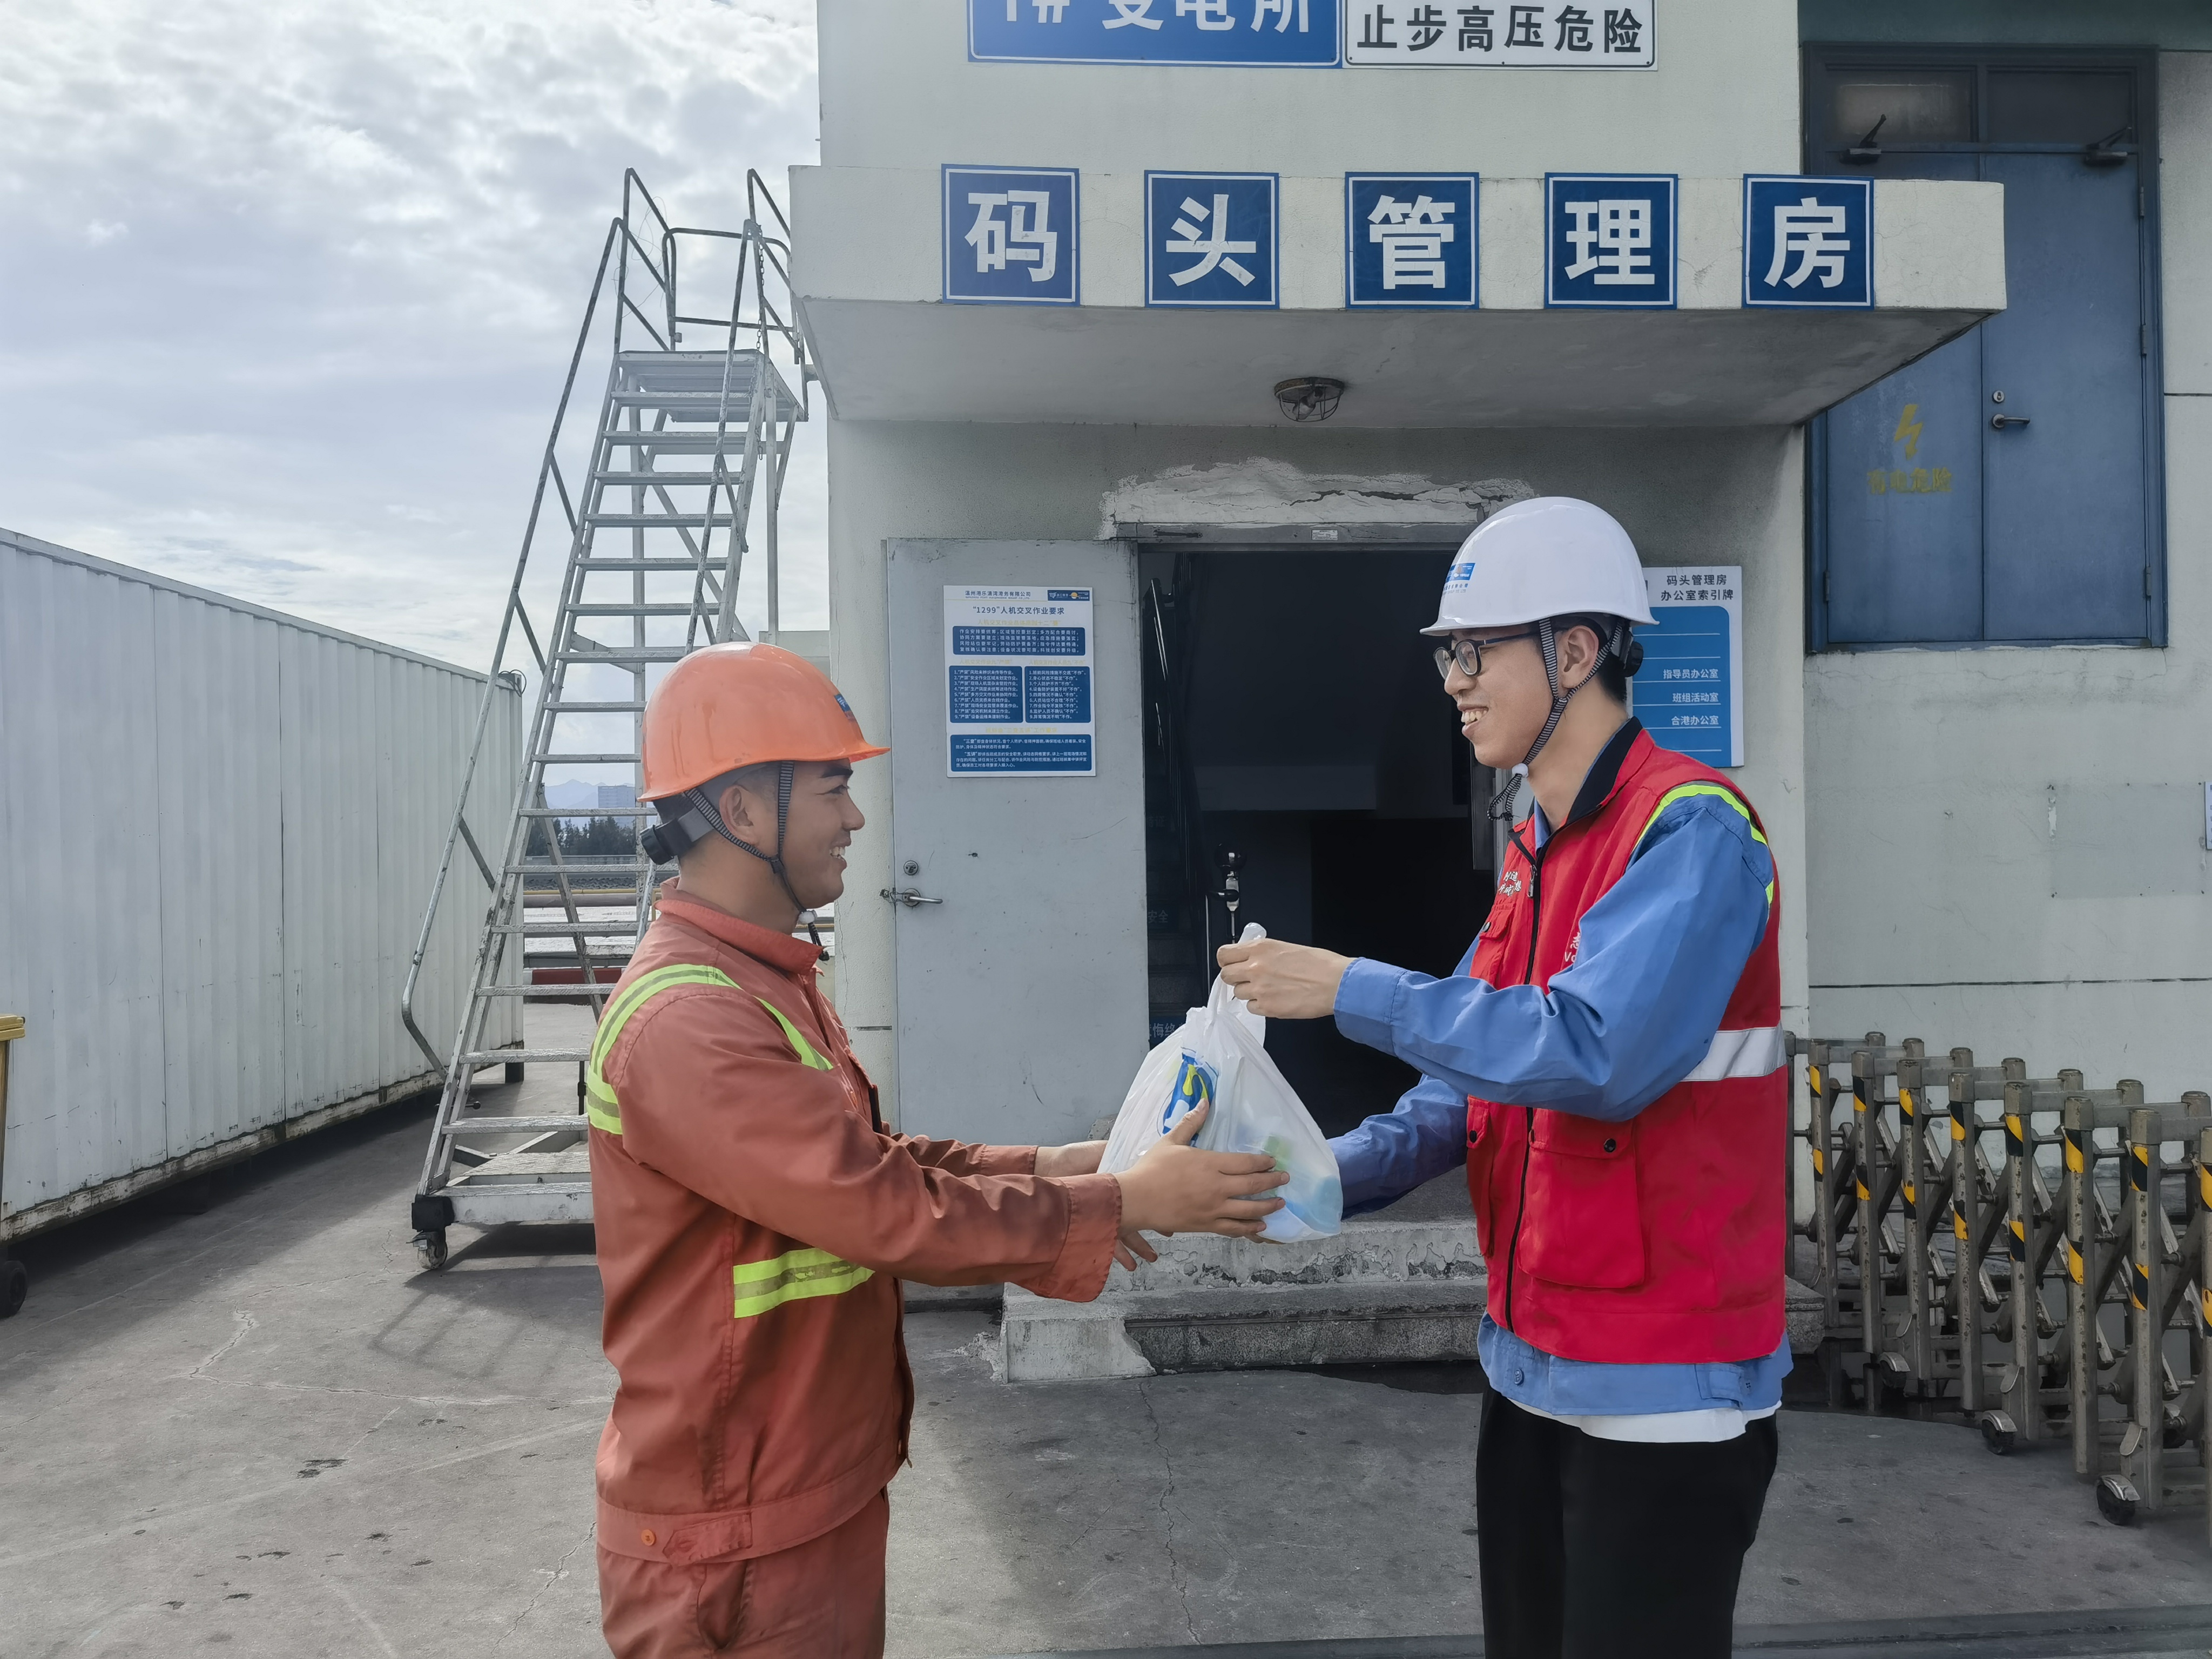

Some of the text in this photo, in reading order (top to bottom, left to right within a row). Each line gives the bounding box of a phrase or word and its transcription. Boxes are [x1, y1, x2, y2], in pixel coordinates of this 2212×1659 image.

[1357, 4, 1643, 53] 止步高压危险
[964, 190, 1851, 289] 码头管理房
[1667, 574, 1727, 586] 码头管理房
[1661, 589, 1734, 602] 办公室索引牌
[1663, 669, 1718, 679] 指导员办公室
[1672, 692, 1719, 703] 班组活动室
[1671, 716, 1719, 726] 合港办公室
